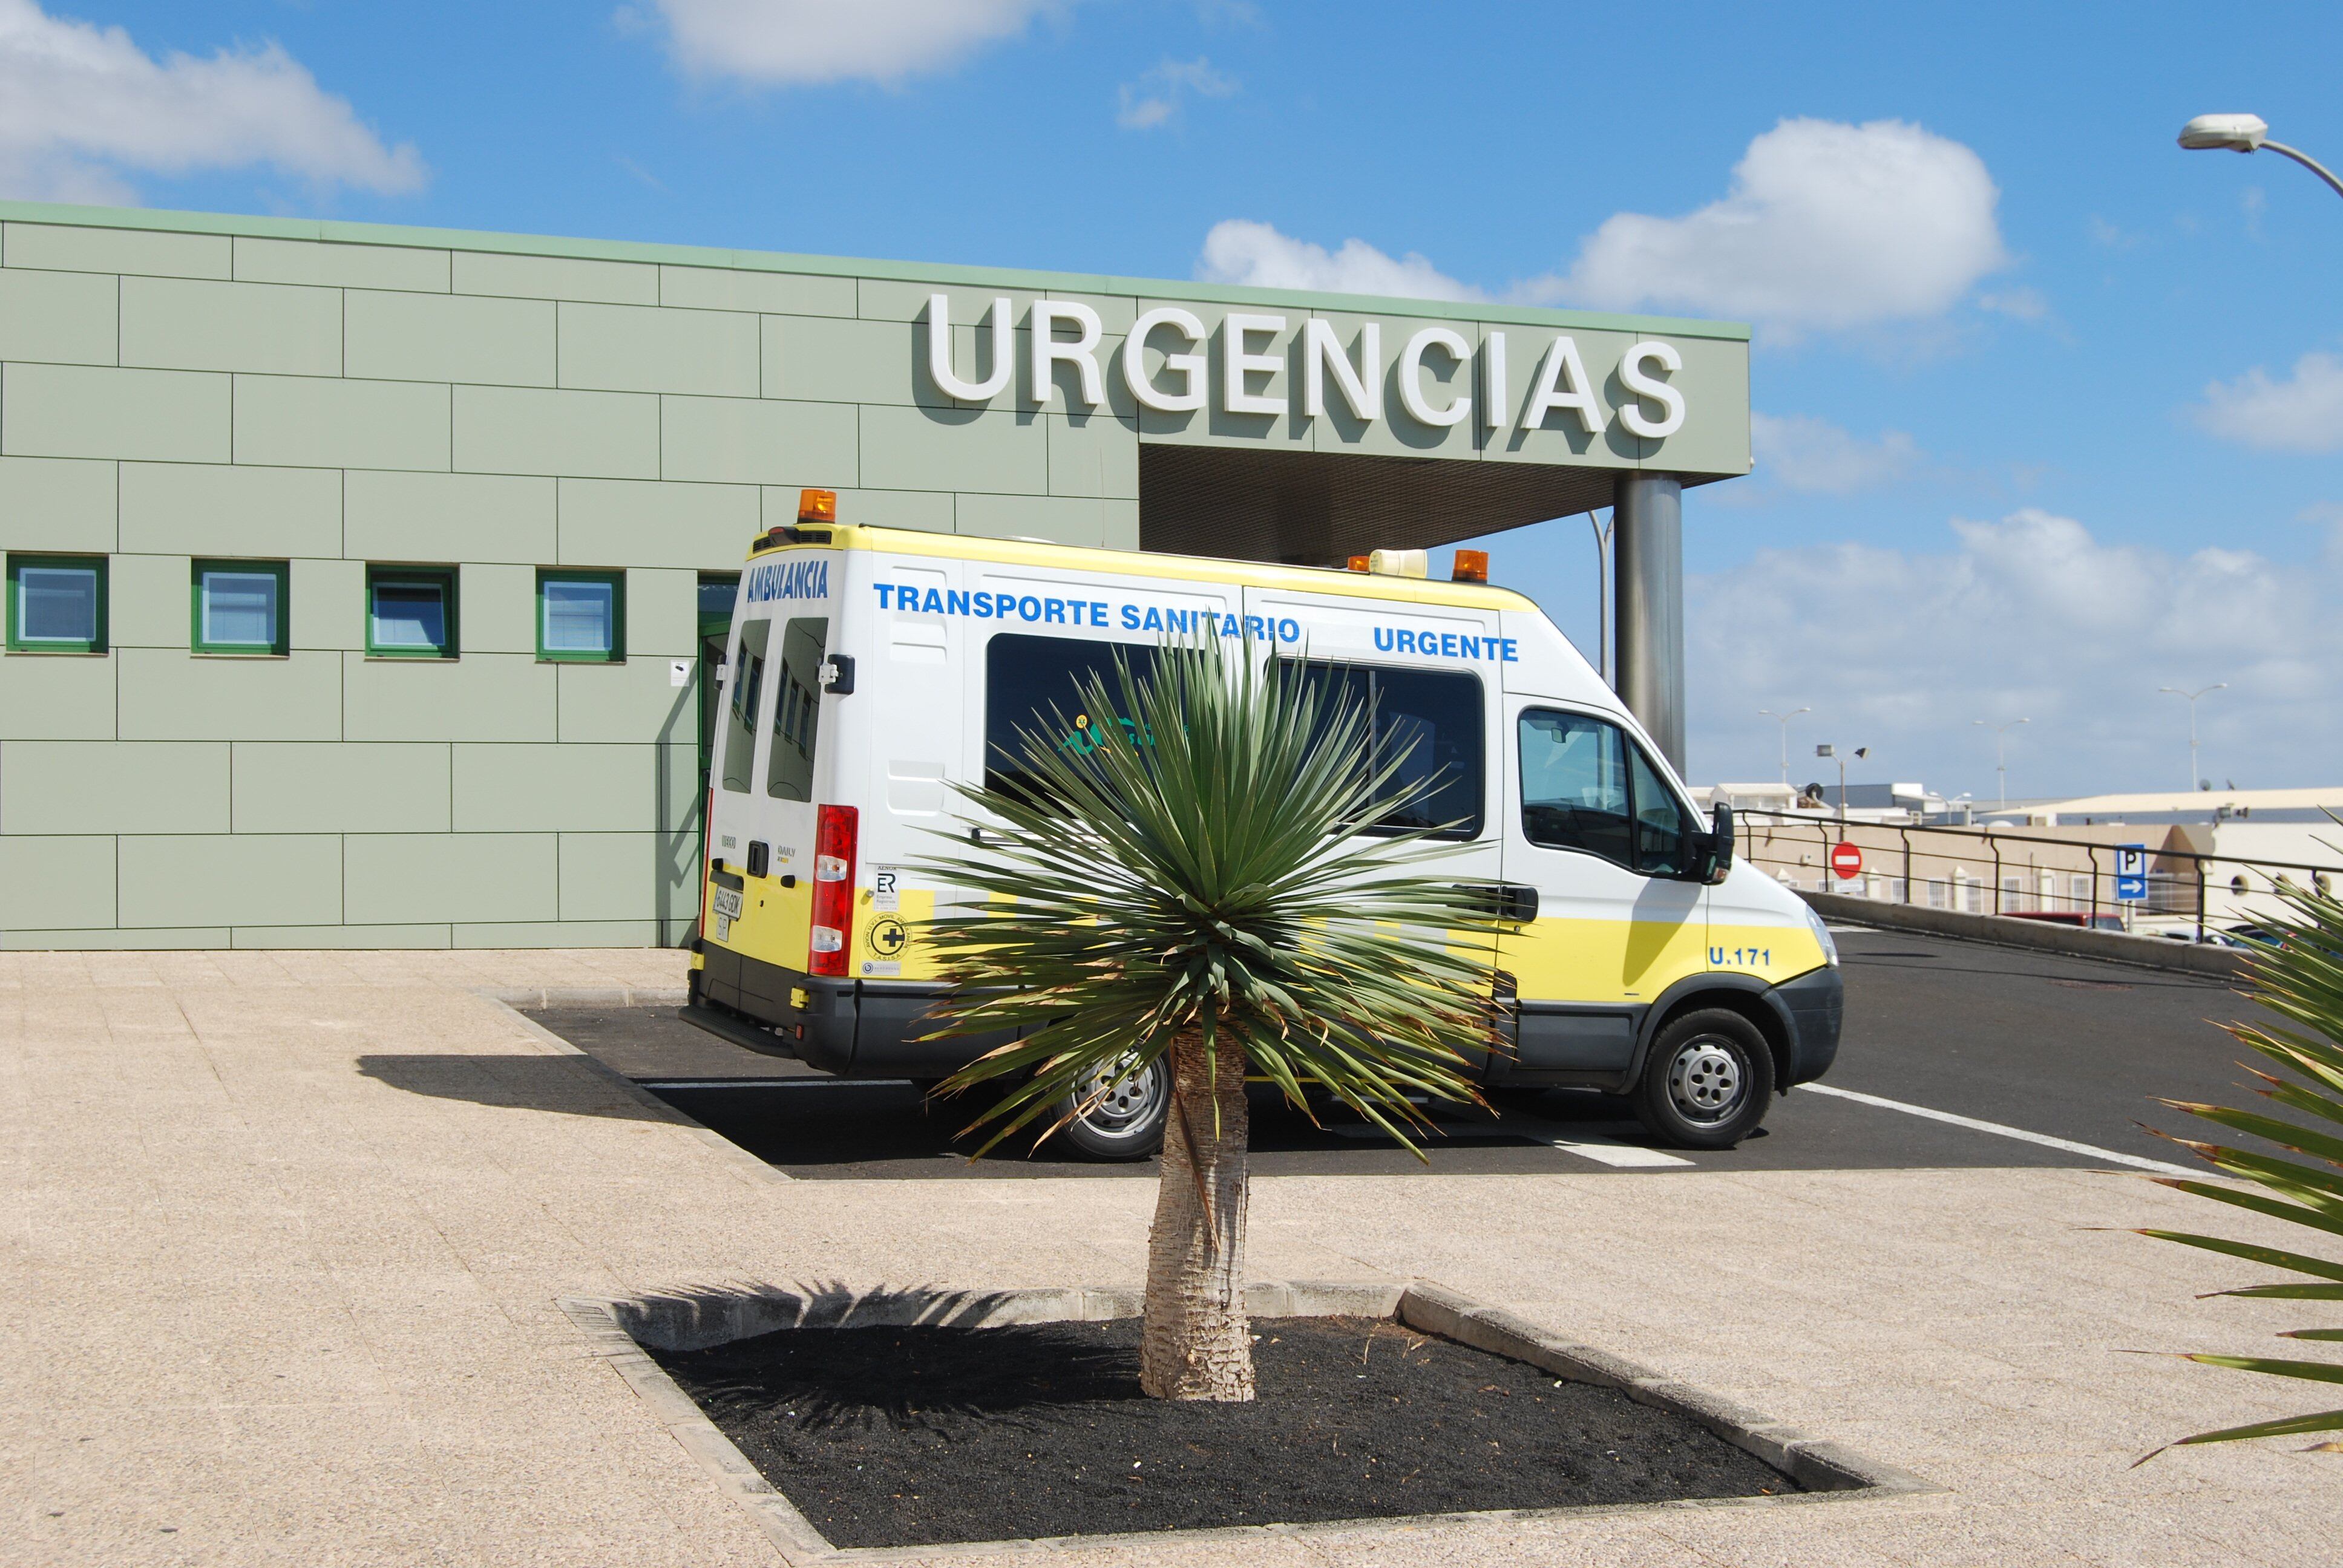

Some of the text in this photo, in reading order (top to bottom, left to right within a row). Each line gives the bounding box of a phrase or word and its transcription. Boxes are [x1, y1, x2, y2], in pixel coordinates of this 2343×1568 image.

[929, 293, 1686, 439] URGENCIAS
[747, 560, 828, 603] AMBULANCIA
[873, 583, 1519, 662] TRANSPORTE SANITARIO URGENTE
[721, 834, 736, 849] IVECO
[778, 845, 796, 858] DAILY
[2125, 848, 2137, 871] P
[718, 916, 727, 936] SP
[1709, 946, 1771, 967] U.171
